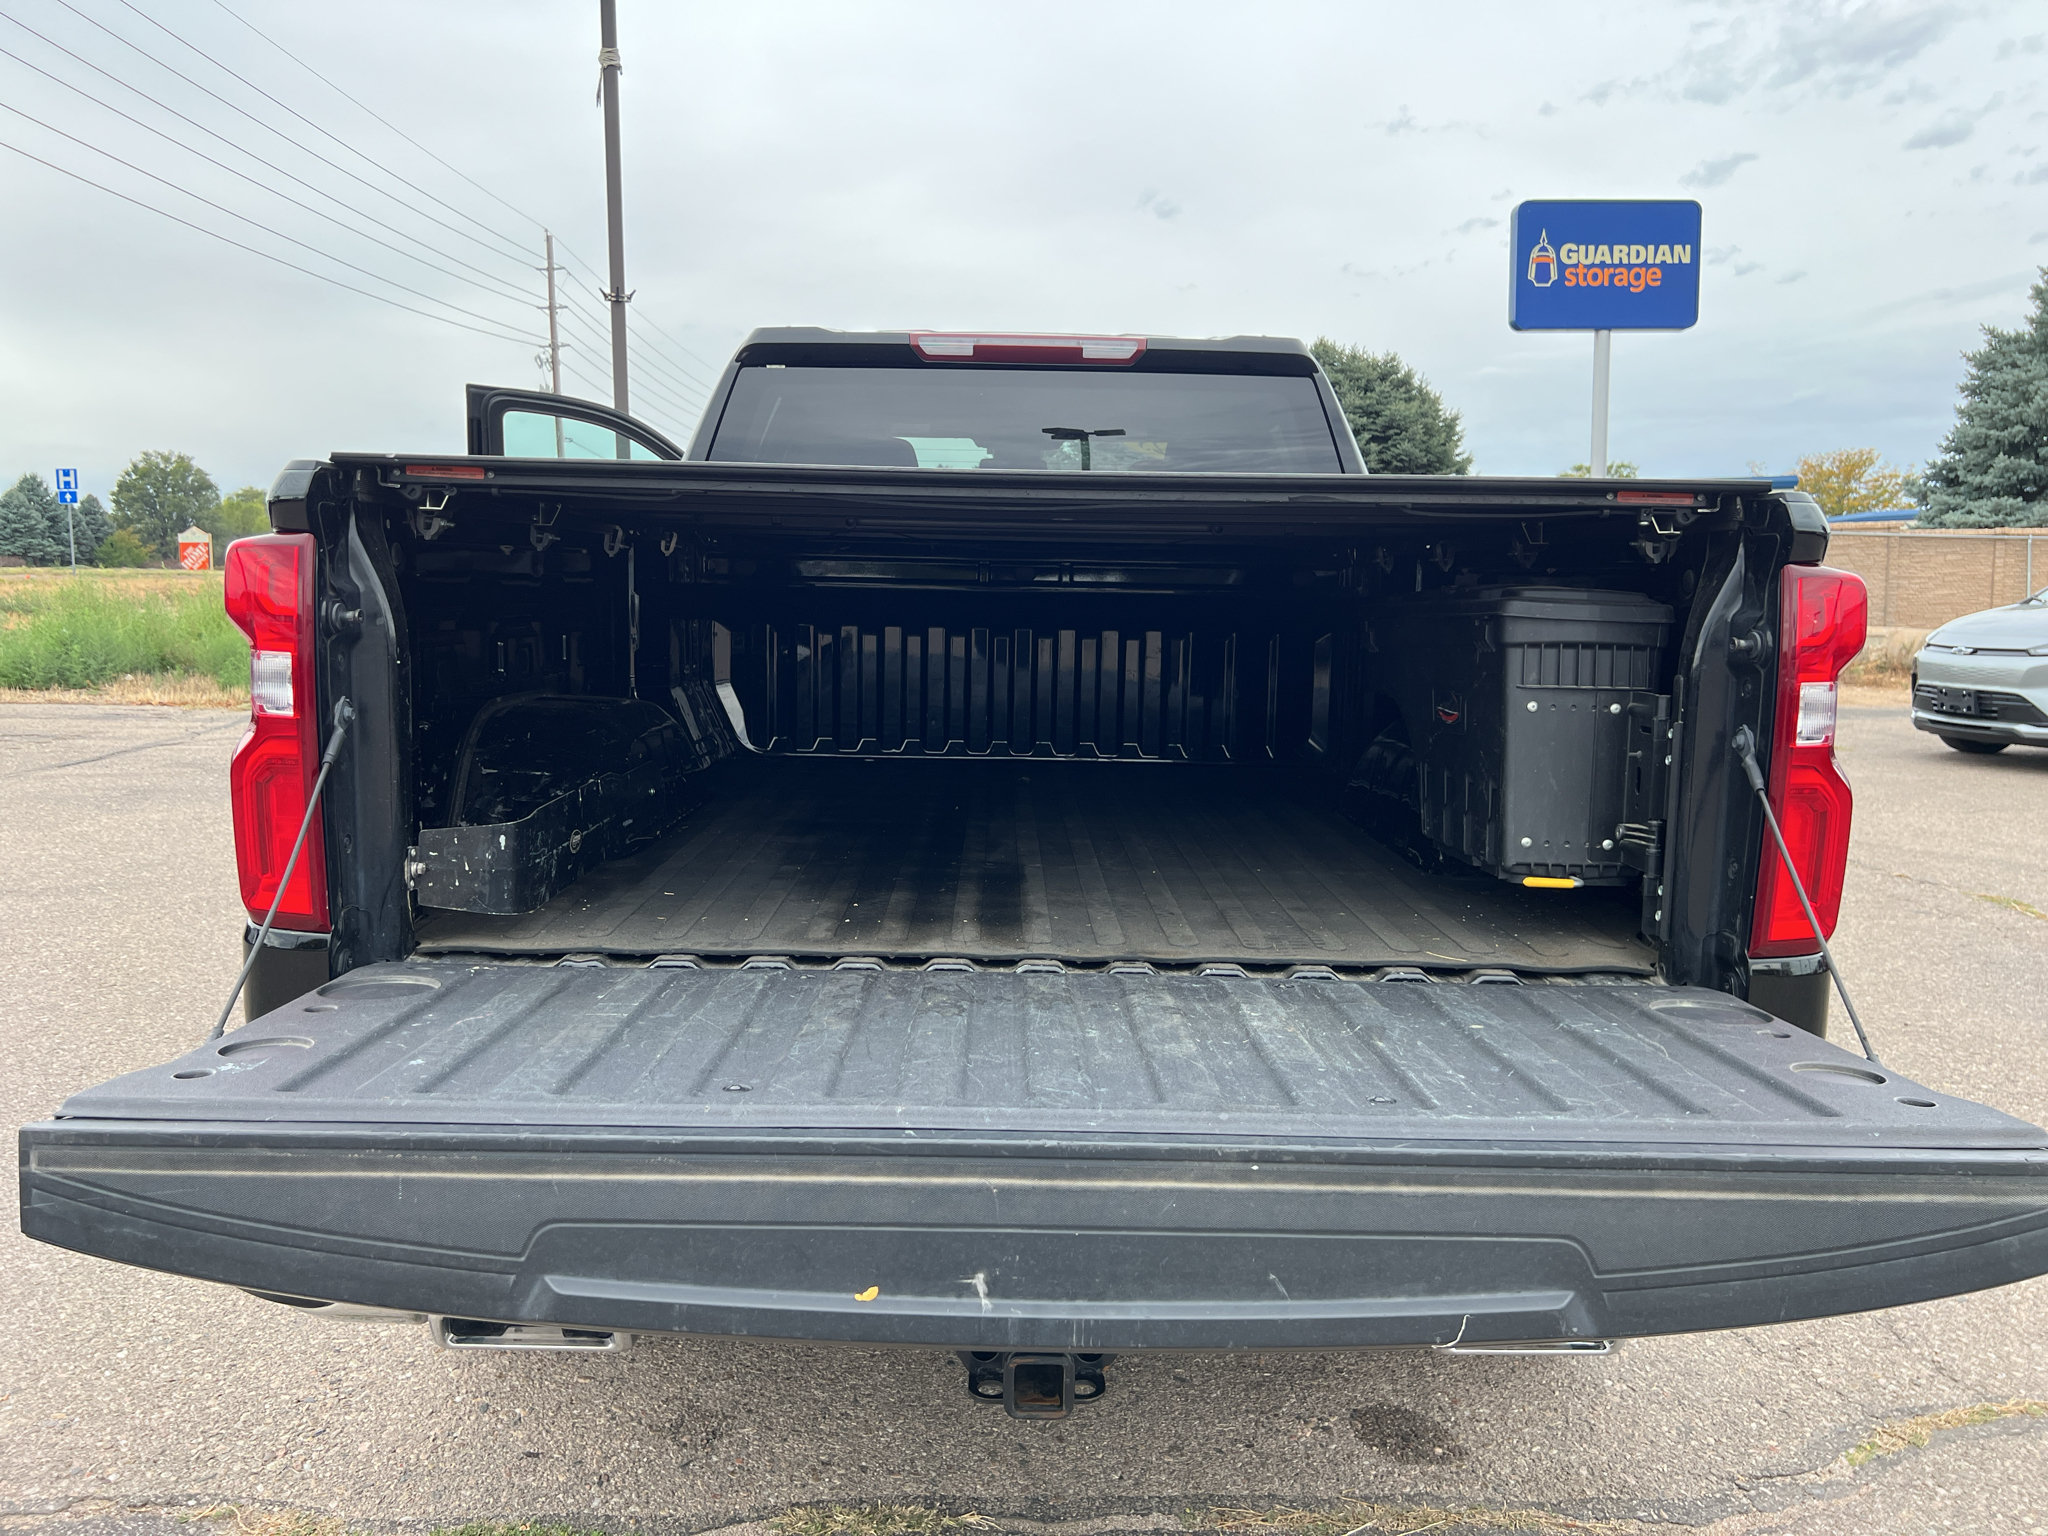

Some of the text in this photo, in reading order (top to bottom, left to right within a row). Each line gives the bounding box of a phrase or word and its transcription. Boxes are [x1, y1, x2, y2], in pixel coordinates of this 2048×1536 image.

[1560, 243, 1691, 265] GUARDIAN
[1565, 263, 1662, 293] storage
[58, 470, 76, 489] H
